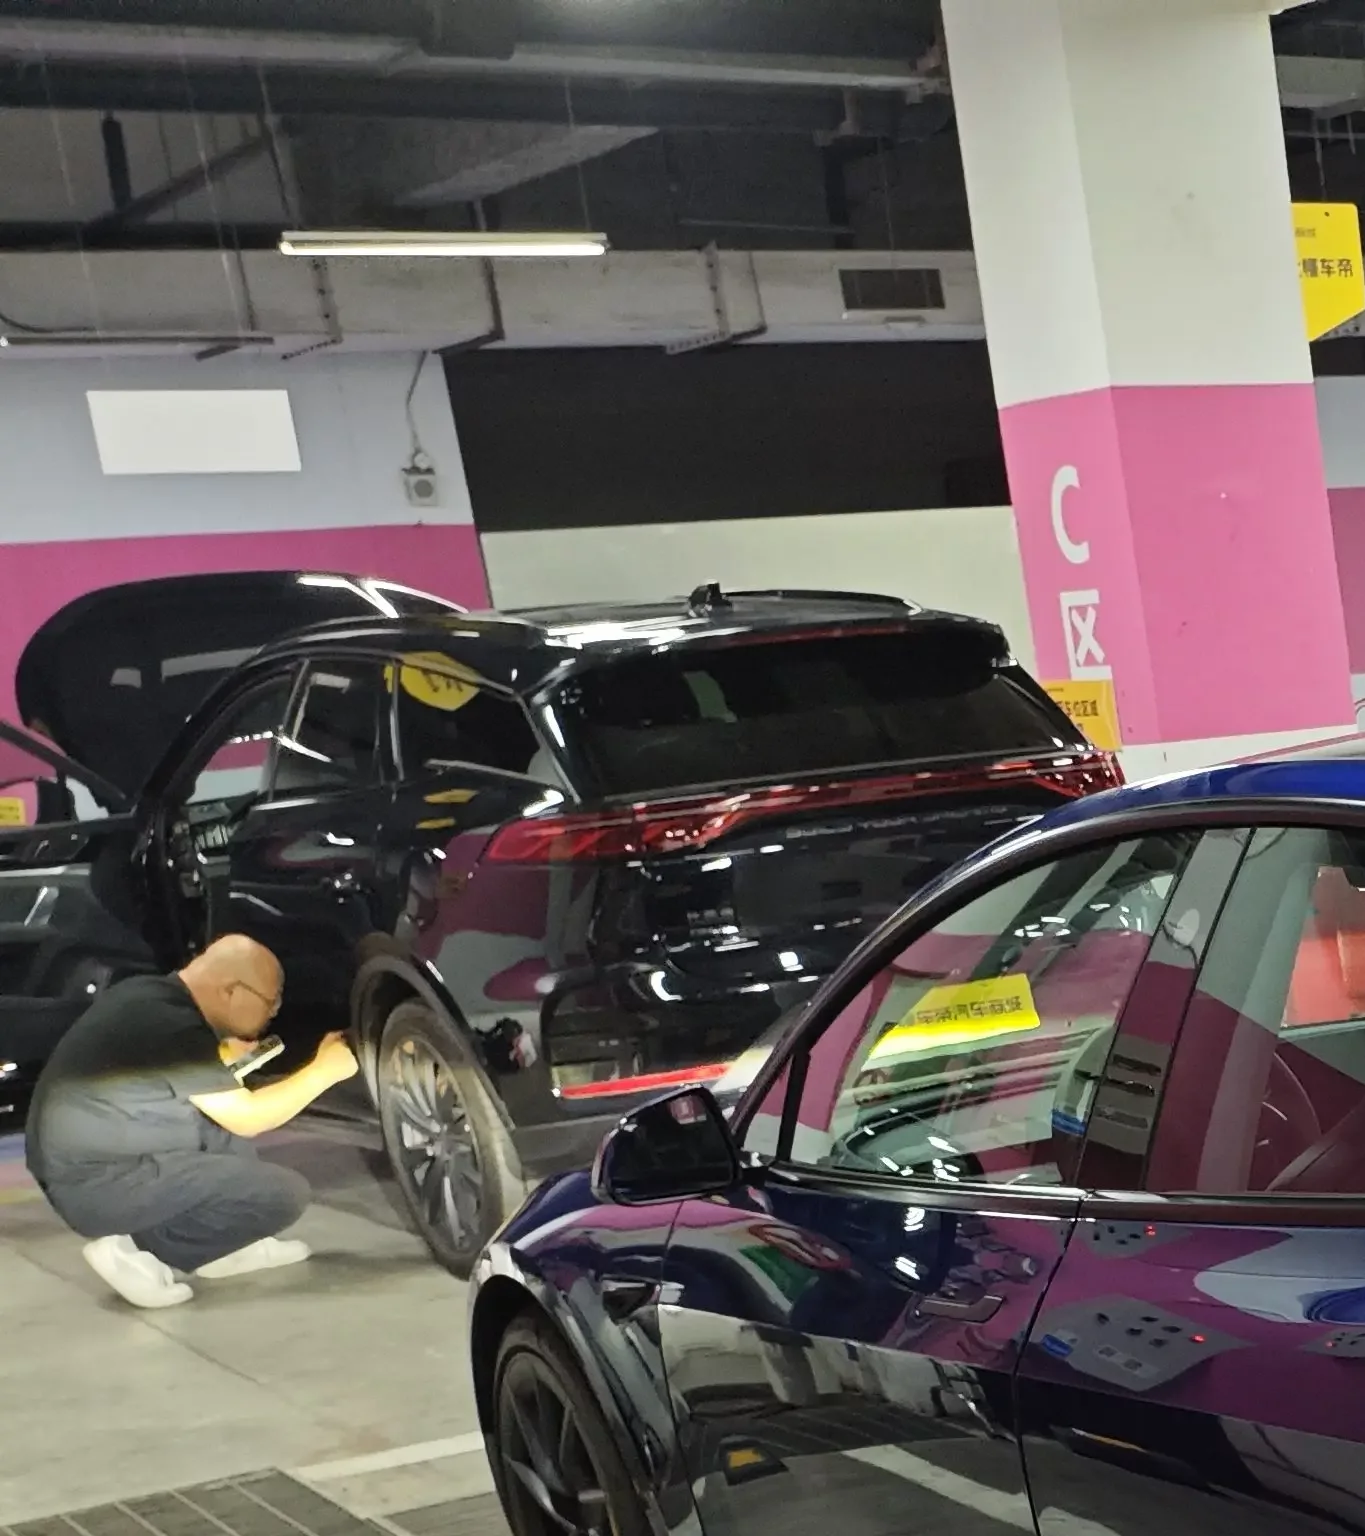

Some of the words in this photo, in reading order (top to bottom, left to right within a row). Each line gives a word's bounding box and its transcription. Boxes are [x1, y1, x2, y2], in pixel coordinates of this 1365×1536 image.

[1298, 257, 1354, 278] 懂车帝
[1051, 465, 1113, 681] C区
